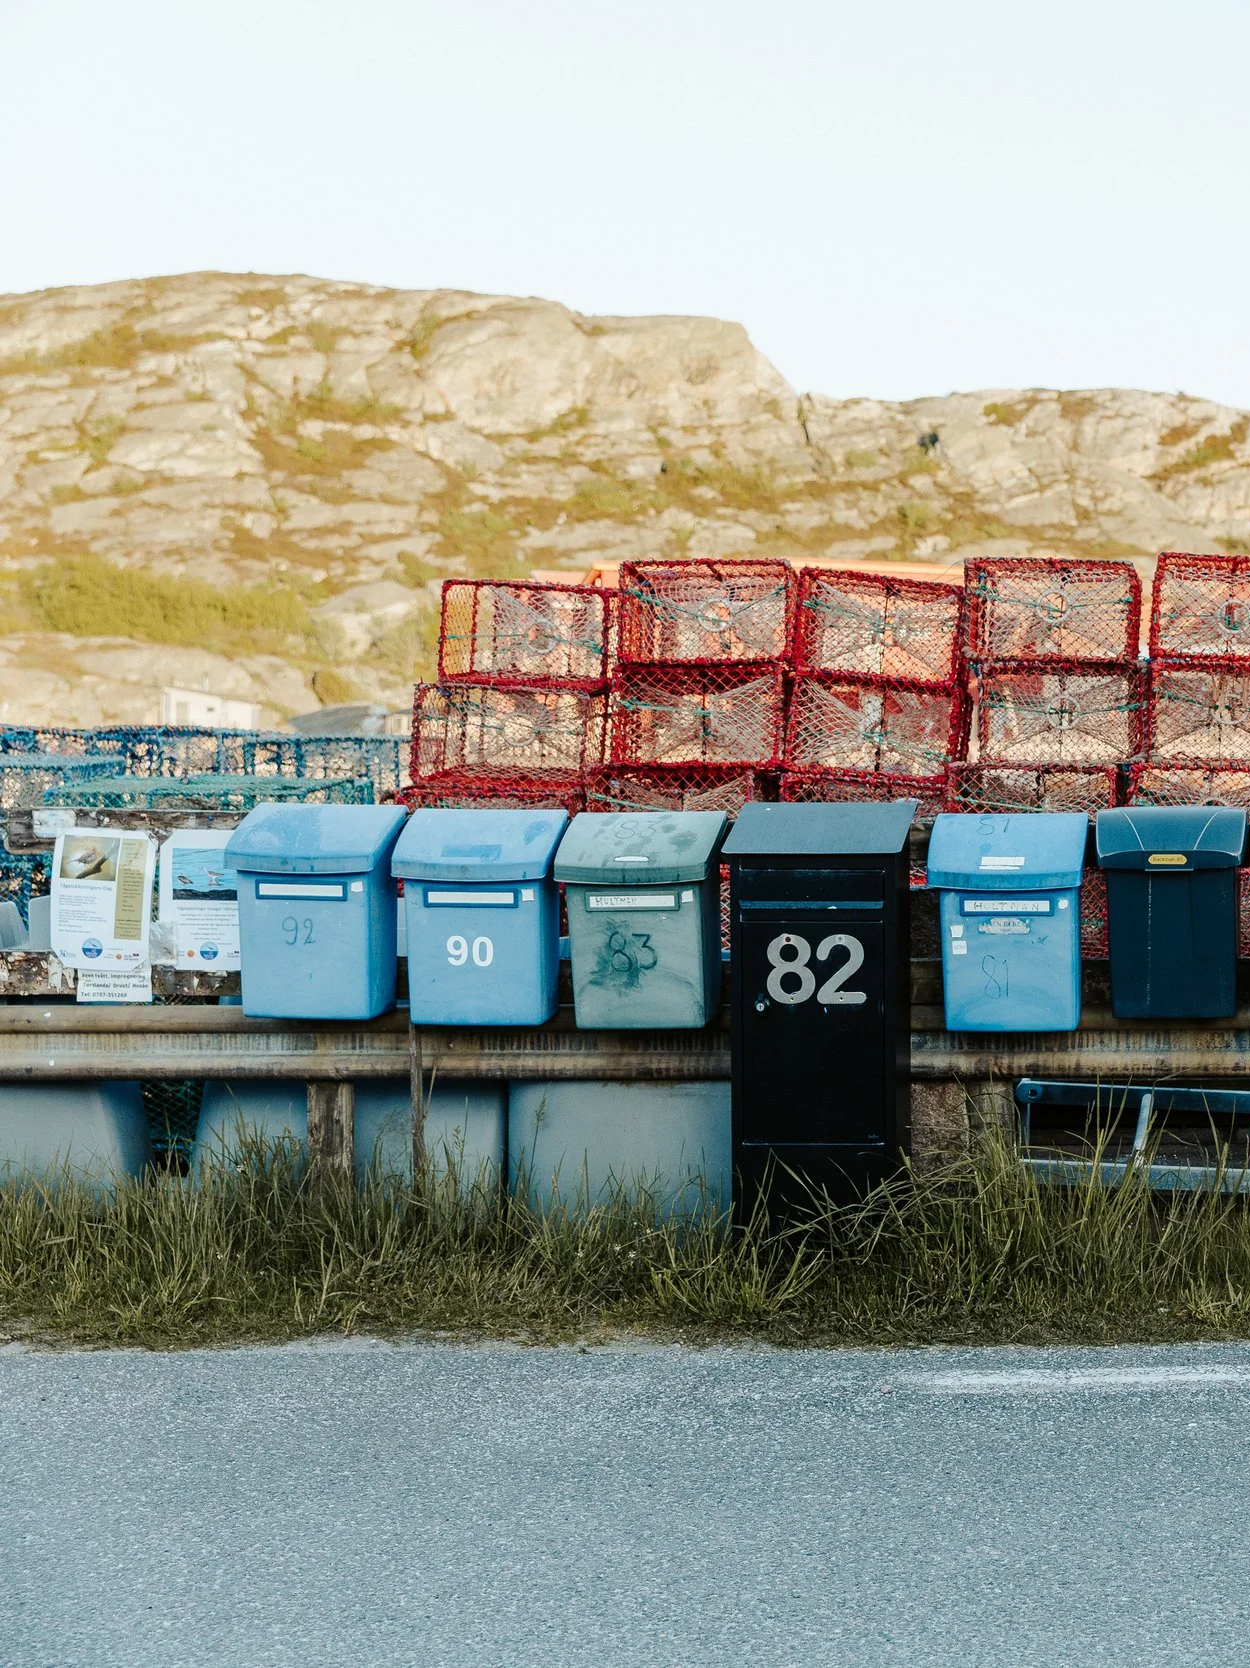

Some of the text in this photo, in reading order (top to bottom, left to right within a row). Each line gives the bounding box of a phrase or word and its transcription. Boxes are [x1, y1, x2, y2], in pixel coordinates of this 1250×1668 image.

[614, 820, 661, 840] 83
[282, 915, 316, 946] 92
[446, 935, 494, 967] 90
[609, 931, 658, 972] 83
[766, 933, 867, 1005] 82
[982, 954, 1009, 1000] 81
